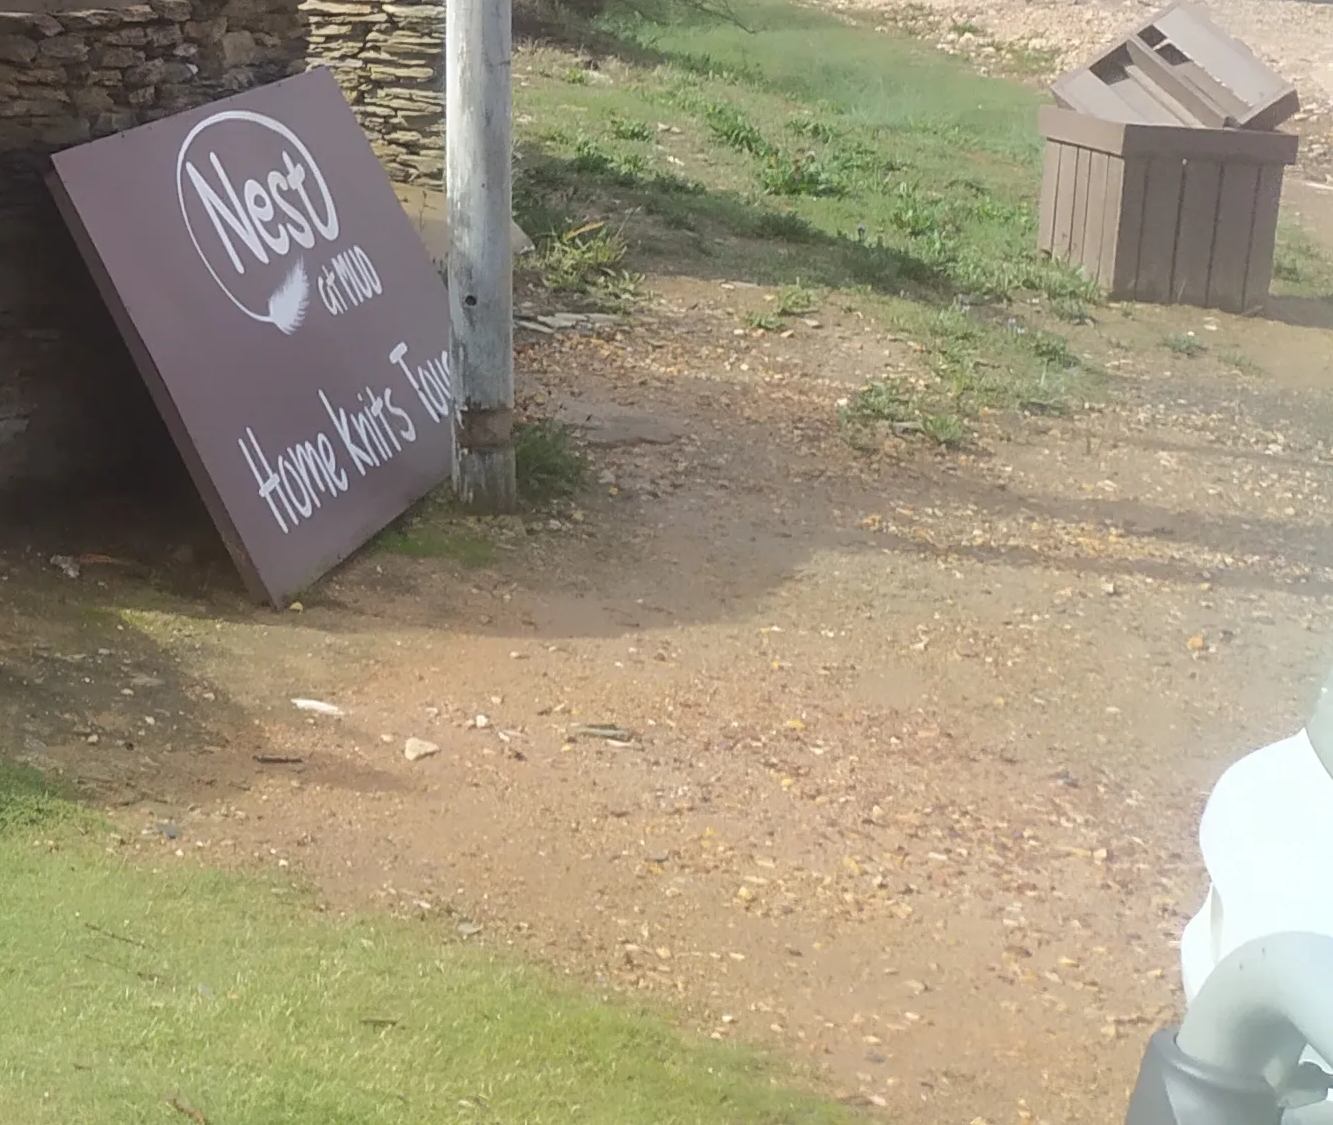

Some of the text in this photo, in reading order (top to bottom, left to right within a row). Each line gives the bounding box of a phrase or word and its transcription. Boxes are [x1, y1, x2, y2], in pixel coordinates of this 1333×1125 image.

[185, 150, 339, 275] Nest
[317, 244, 383, 316] at MUD
[238, 426, 349, 535] Home
[318, 389, 417, 476] Knits
